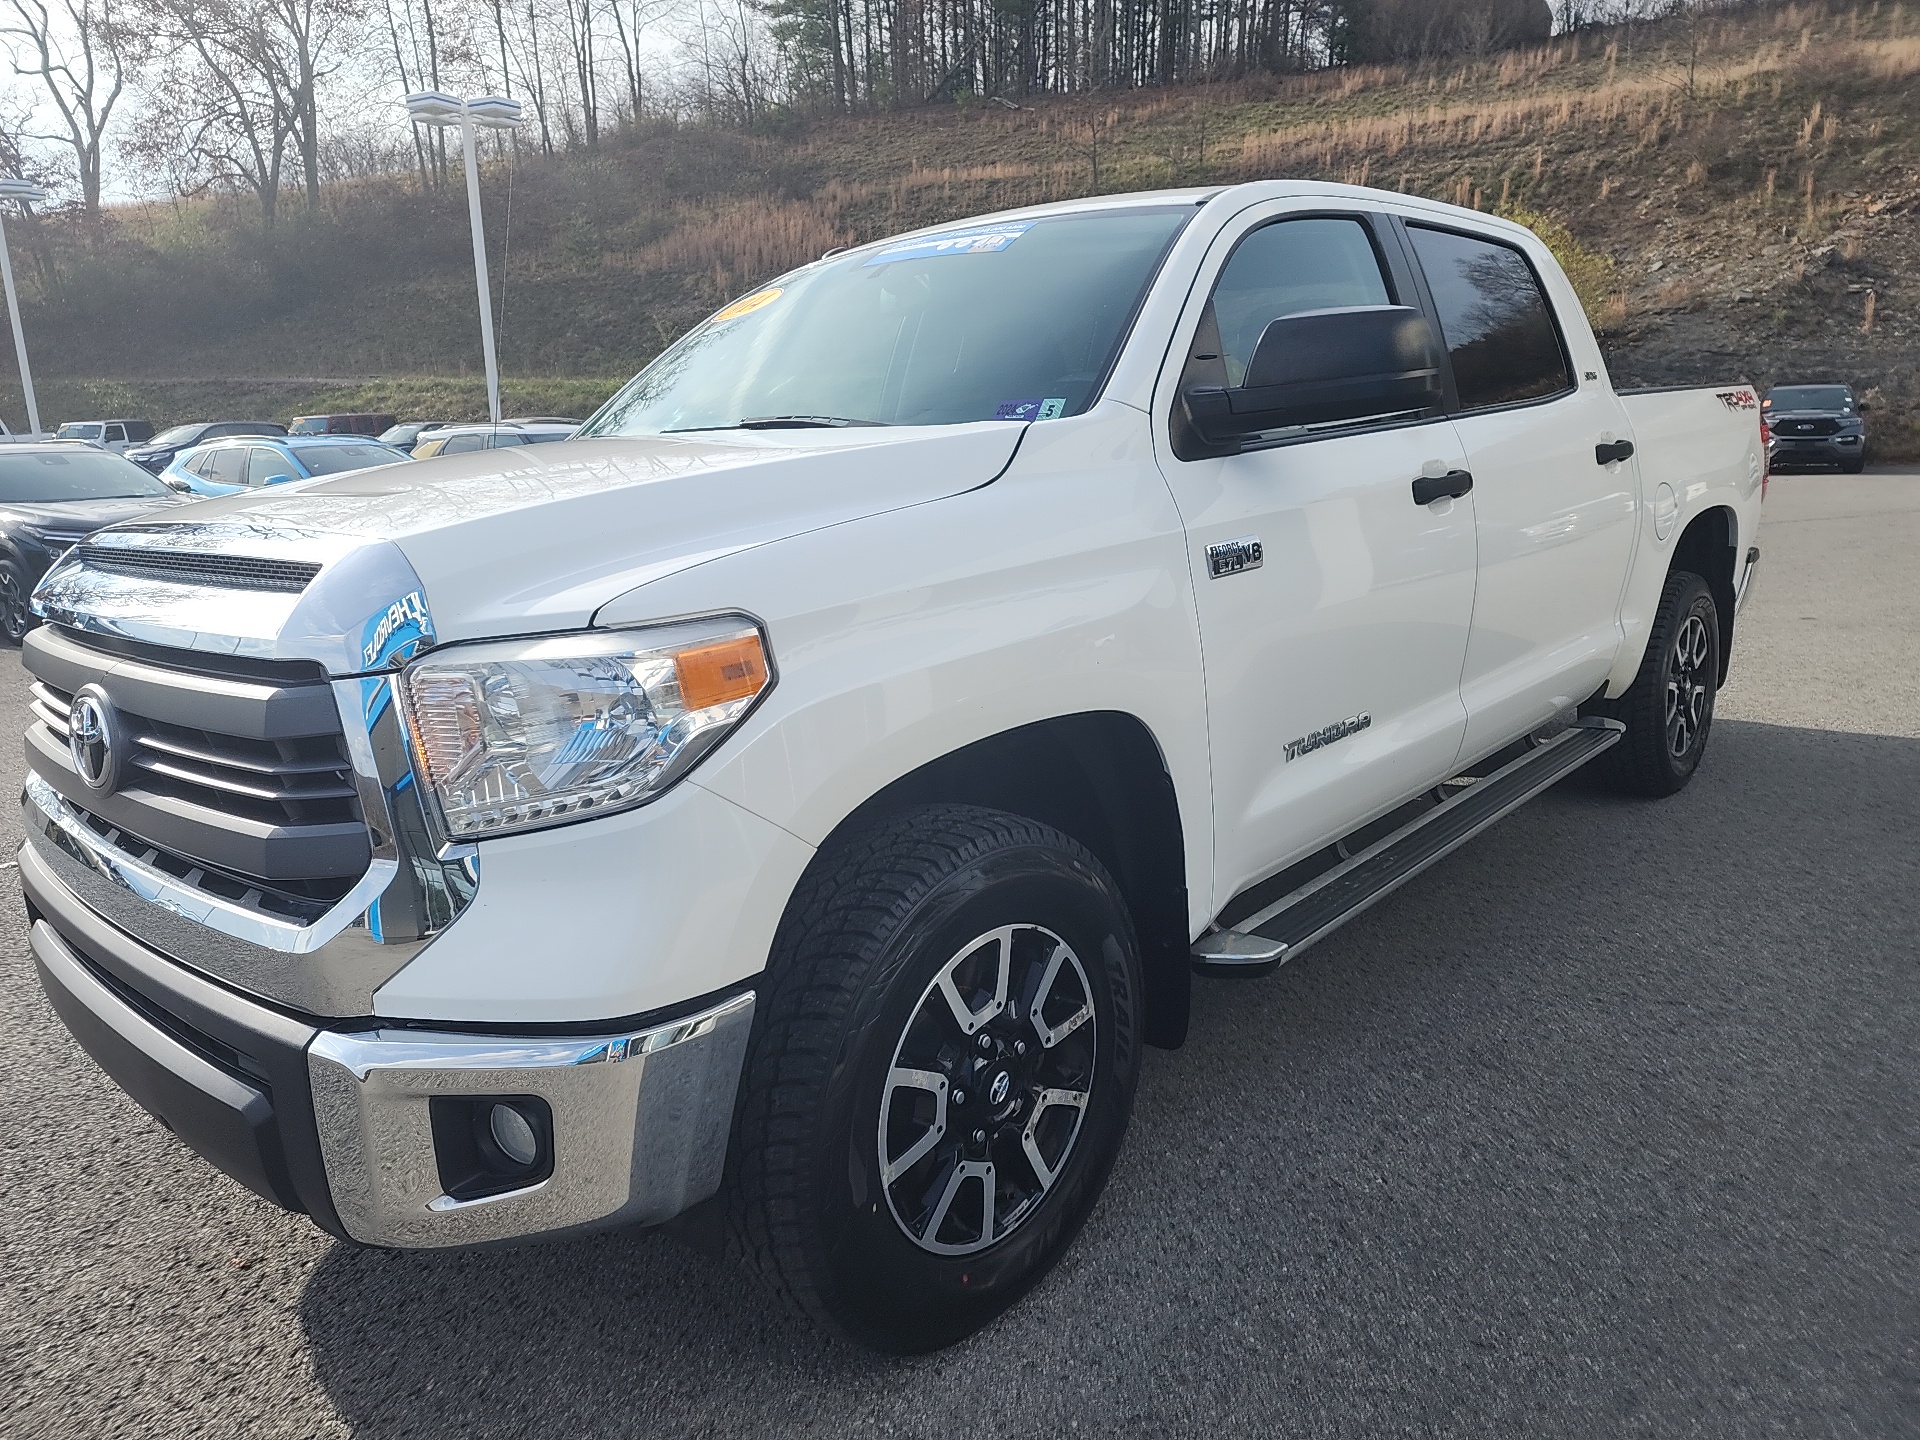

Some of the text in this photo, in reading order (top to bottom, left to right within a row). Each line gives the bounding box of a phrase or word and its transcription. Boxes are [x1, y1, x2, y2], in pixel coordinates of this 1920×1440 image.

[1045, 404, 1056, 418] 5
[1242, 542, 1262, 564] V8
[1282, 710, 1373, 763] TUNDRA
